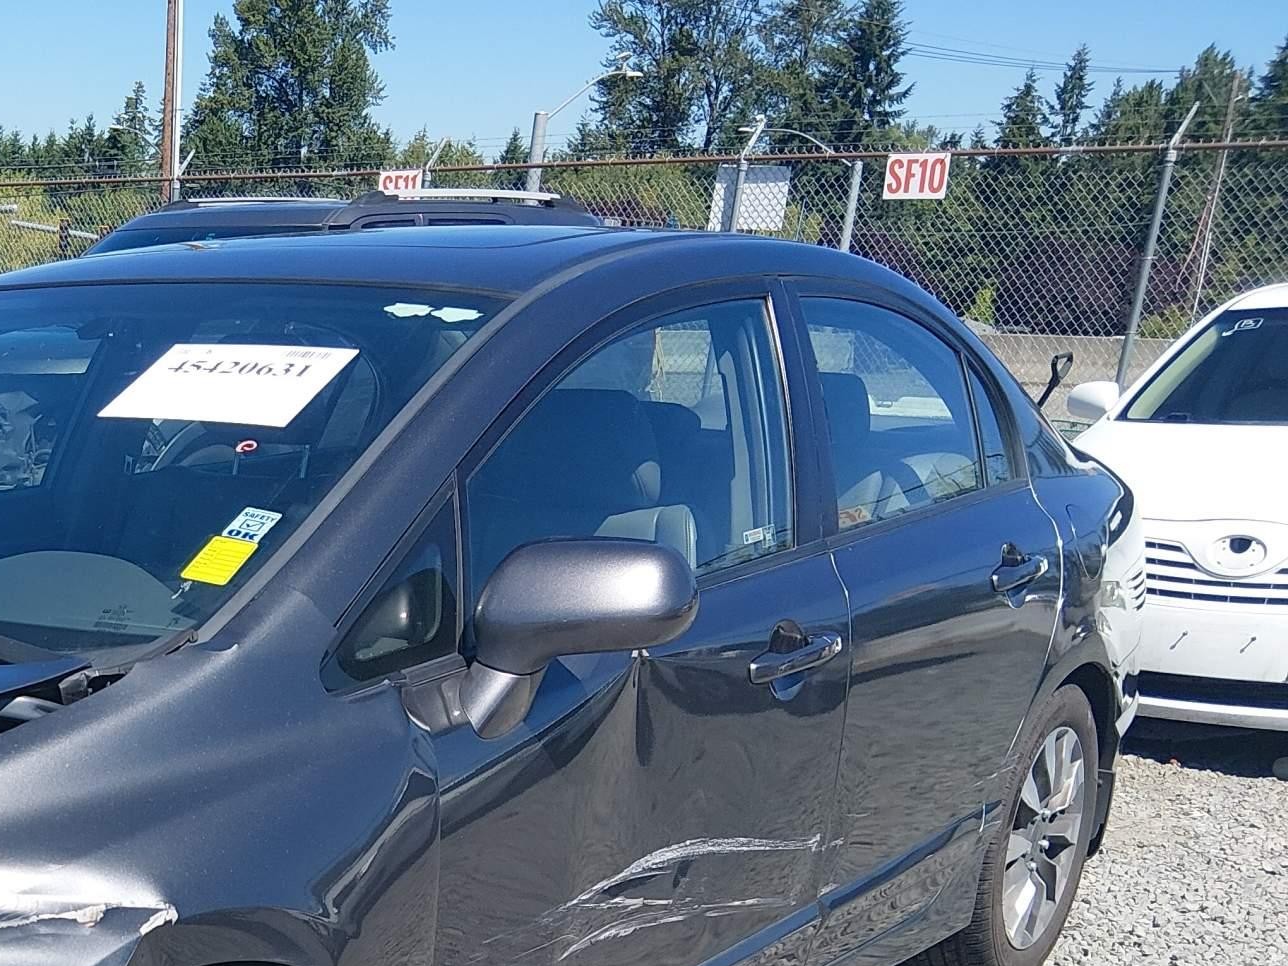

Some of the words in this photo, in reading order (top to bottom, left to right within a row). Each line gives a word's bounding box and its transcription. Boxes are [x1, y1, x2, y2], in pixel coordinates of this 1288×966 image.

[886, 158, 947, 194] SF10
[167, 359, 313, 378] 45420631
[242, 511, 278, 523] SAFETY
[226, 528, 260, 540] OK
